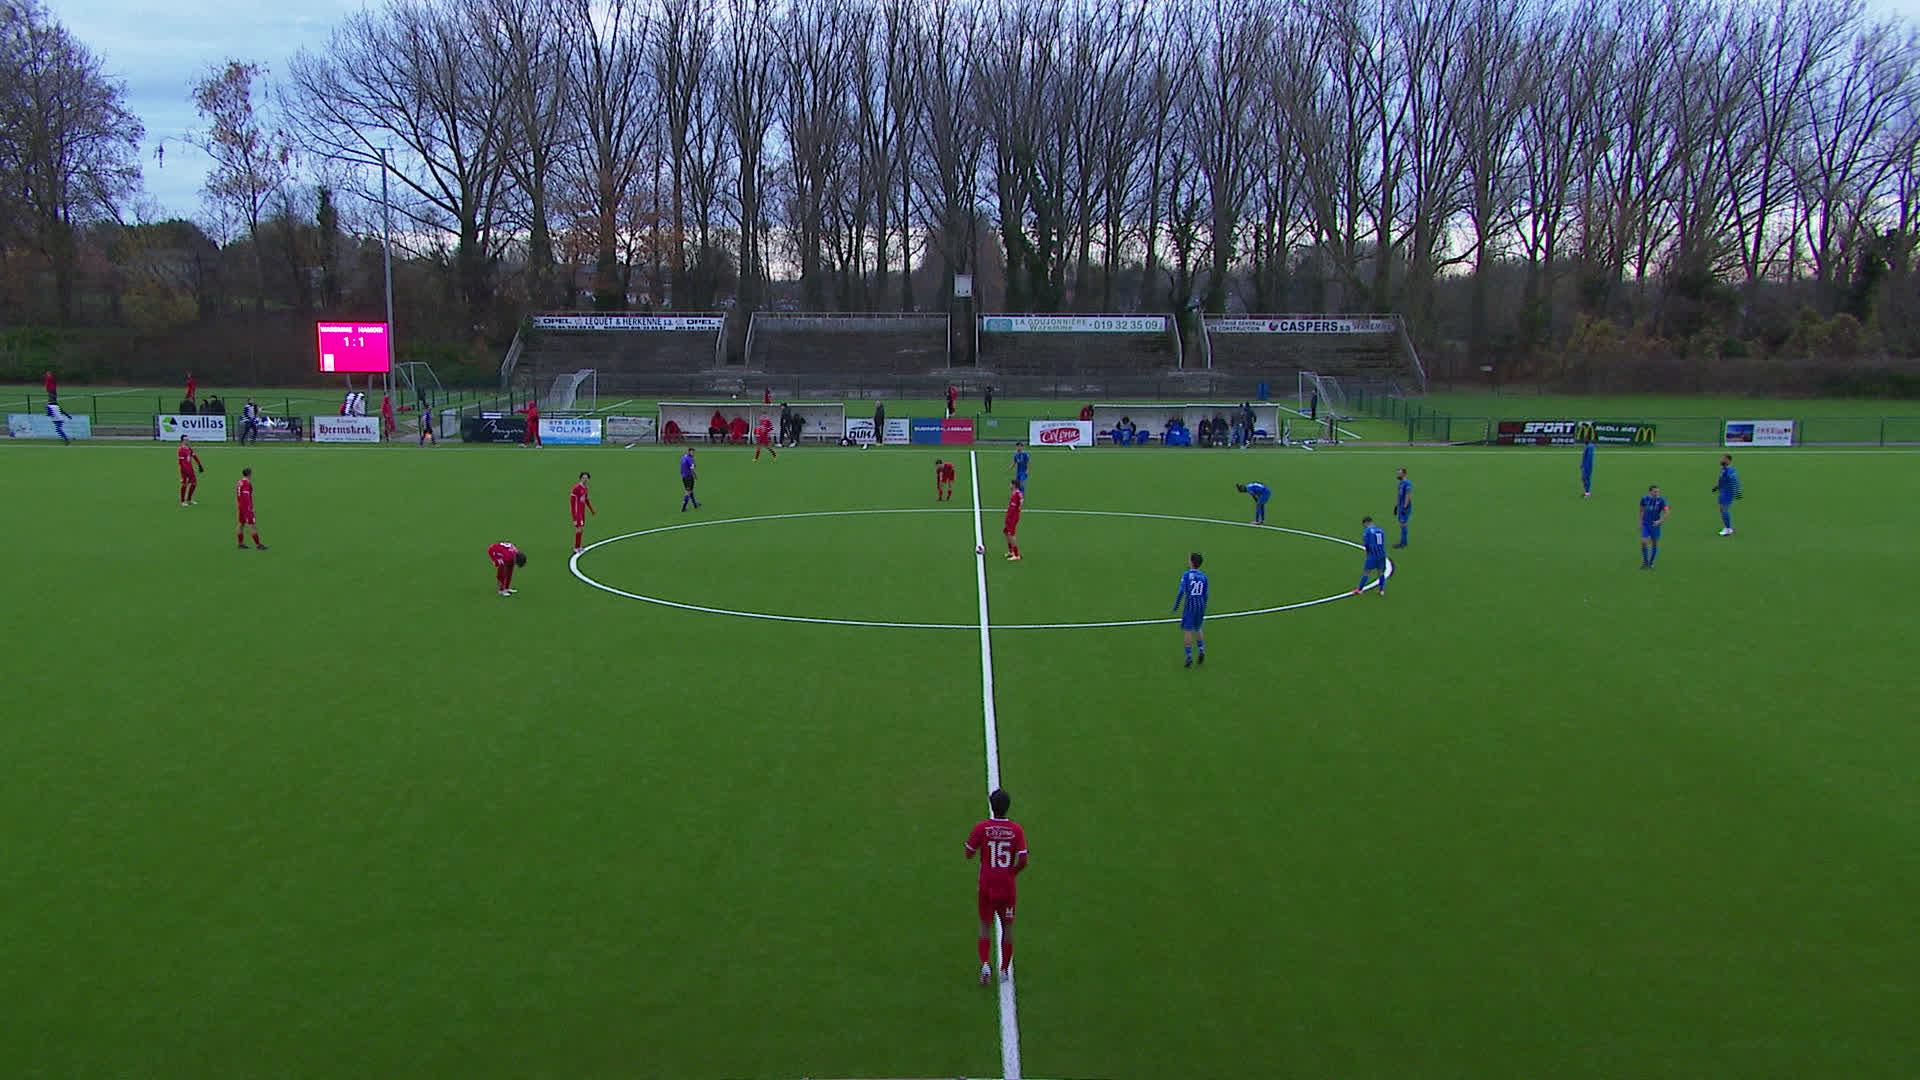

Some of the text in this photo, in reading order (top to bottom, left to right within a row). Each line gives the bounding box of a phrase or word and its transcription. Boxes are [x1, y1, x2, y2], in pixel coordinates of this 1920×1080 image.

[1280, 321, 1339, 332] CASPERS
[1523, 422, 1575, 433] SPORT
[1190, 580, 1204, 596] 20
[987, 840, 1011, 868] 15
